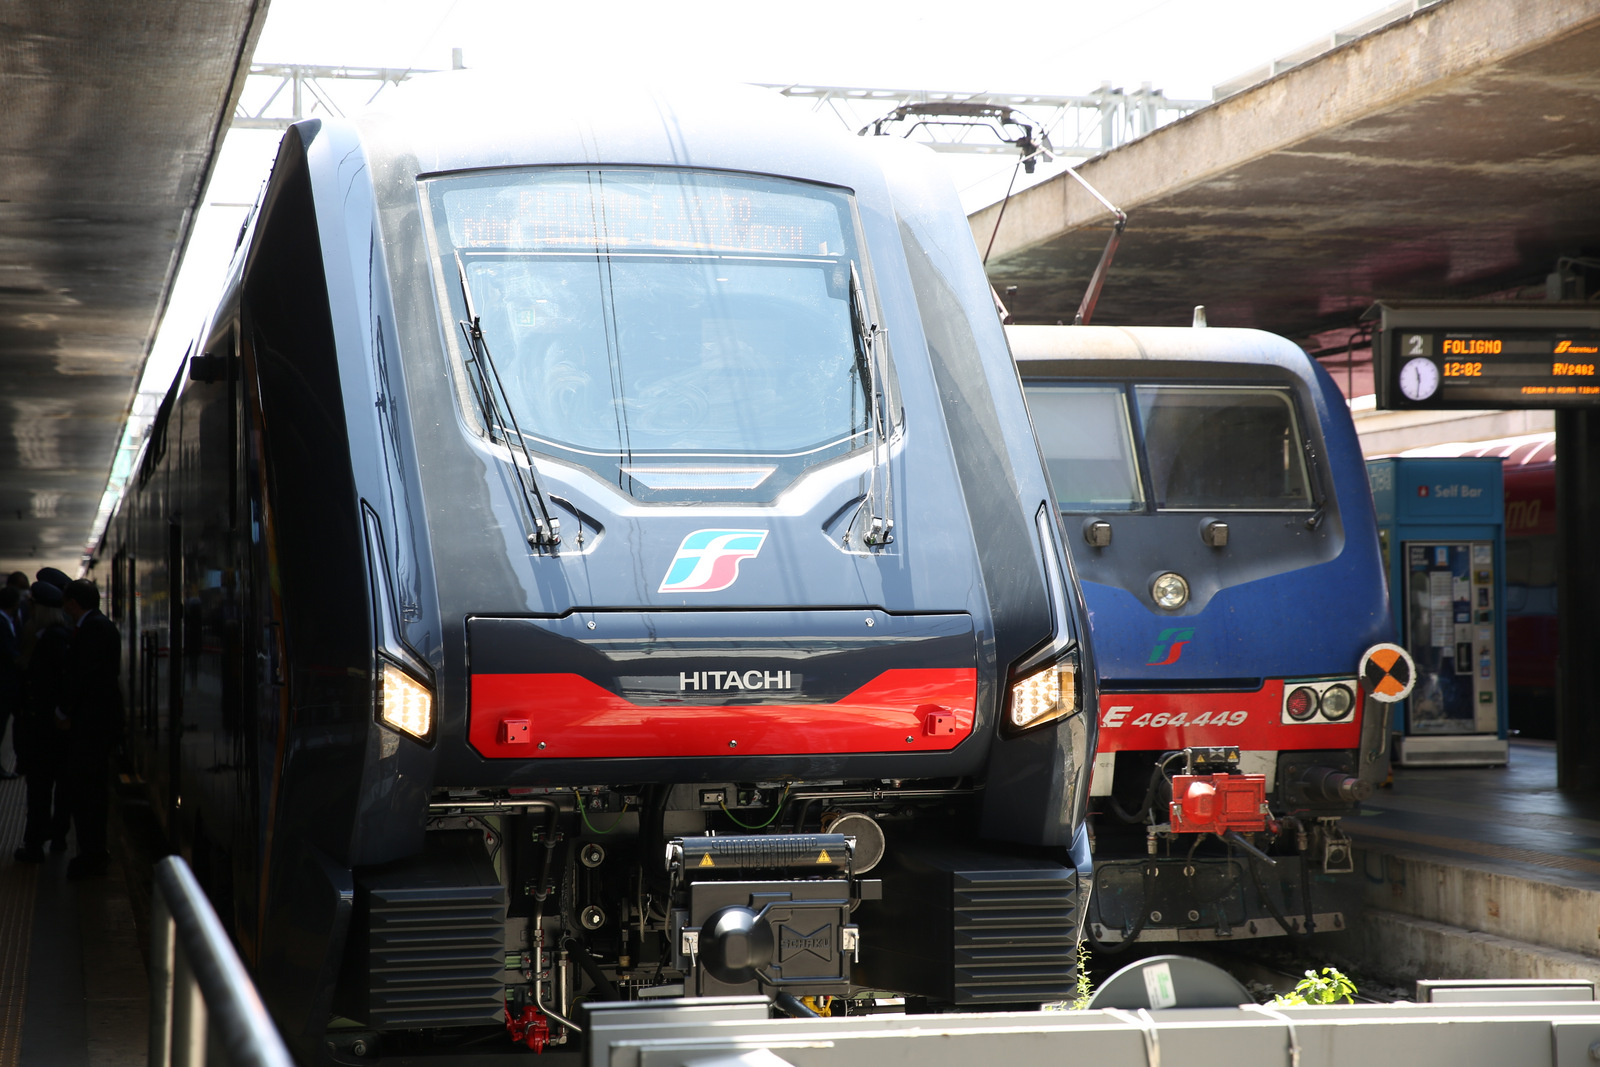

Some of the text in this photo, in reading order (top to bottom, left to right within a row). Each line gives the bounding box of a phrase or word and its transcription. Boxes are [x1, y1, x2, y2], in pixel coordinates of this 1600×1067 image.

[1409, 335, 1424, 355] 2
[1443, 340, 1502, 354] FOLIGNO
[1443, 362, 1482, 376] 12:02
[1434, 484, 1483, 498] Self Bar
[679, 670, 791, 690] HITACHI
[1100, 706, 1248, 728] E 464.449
